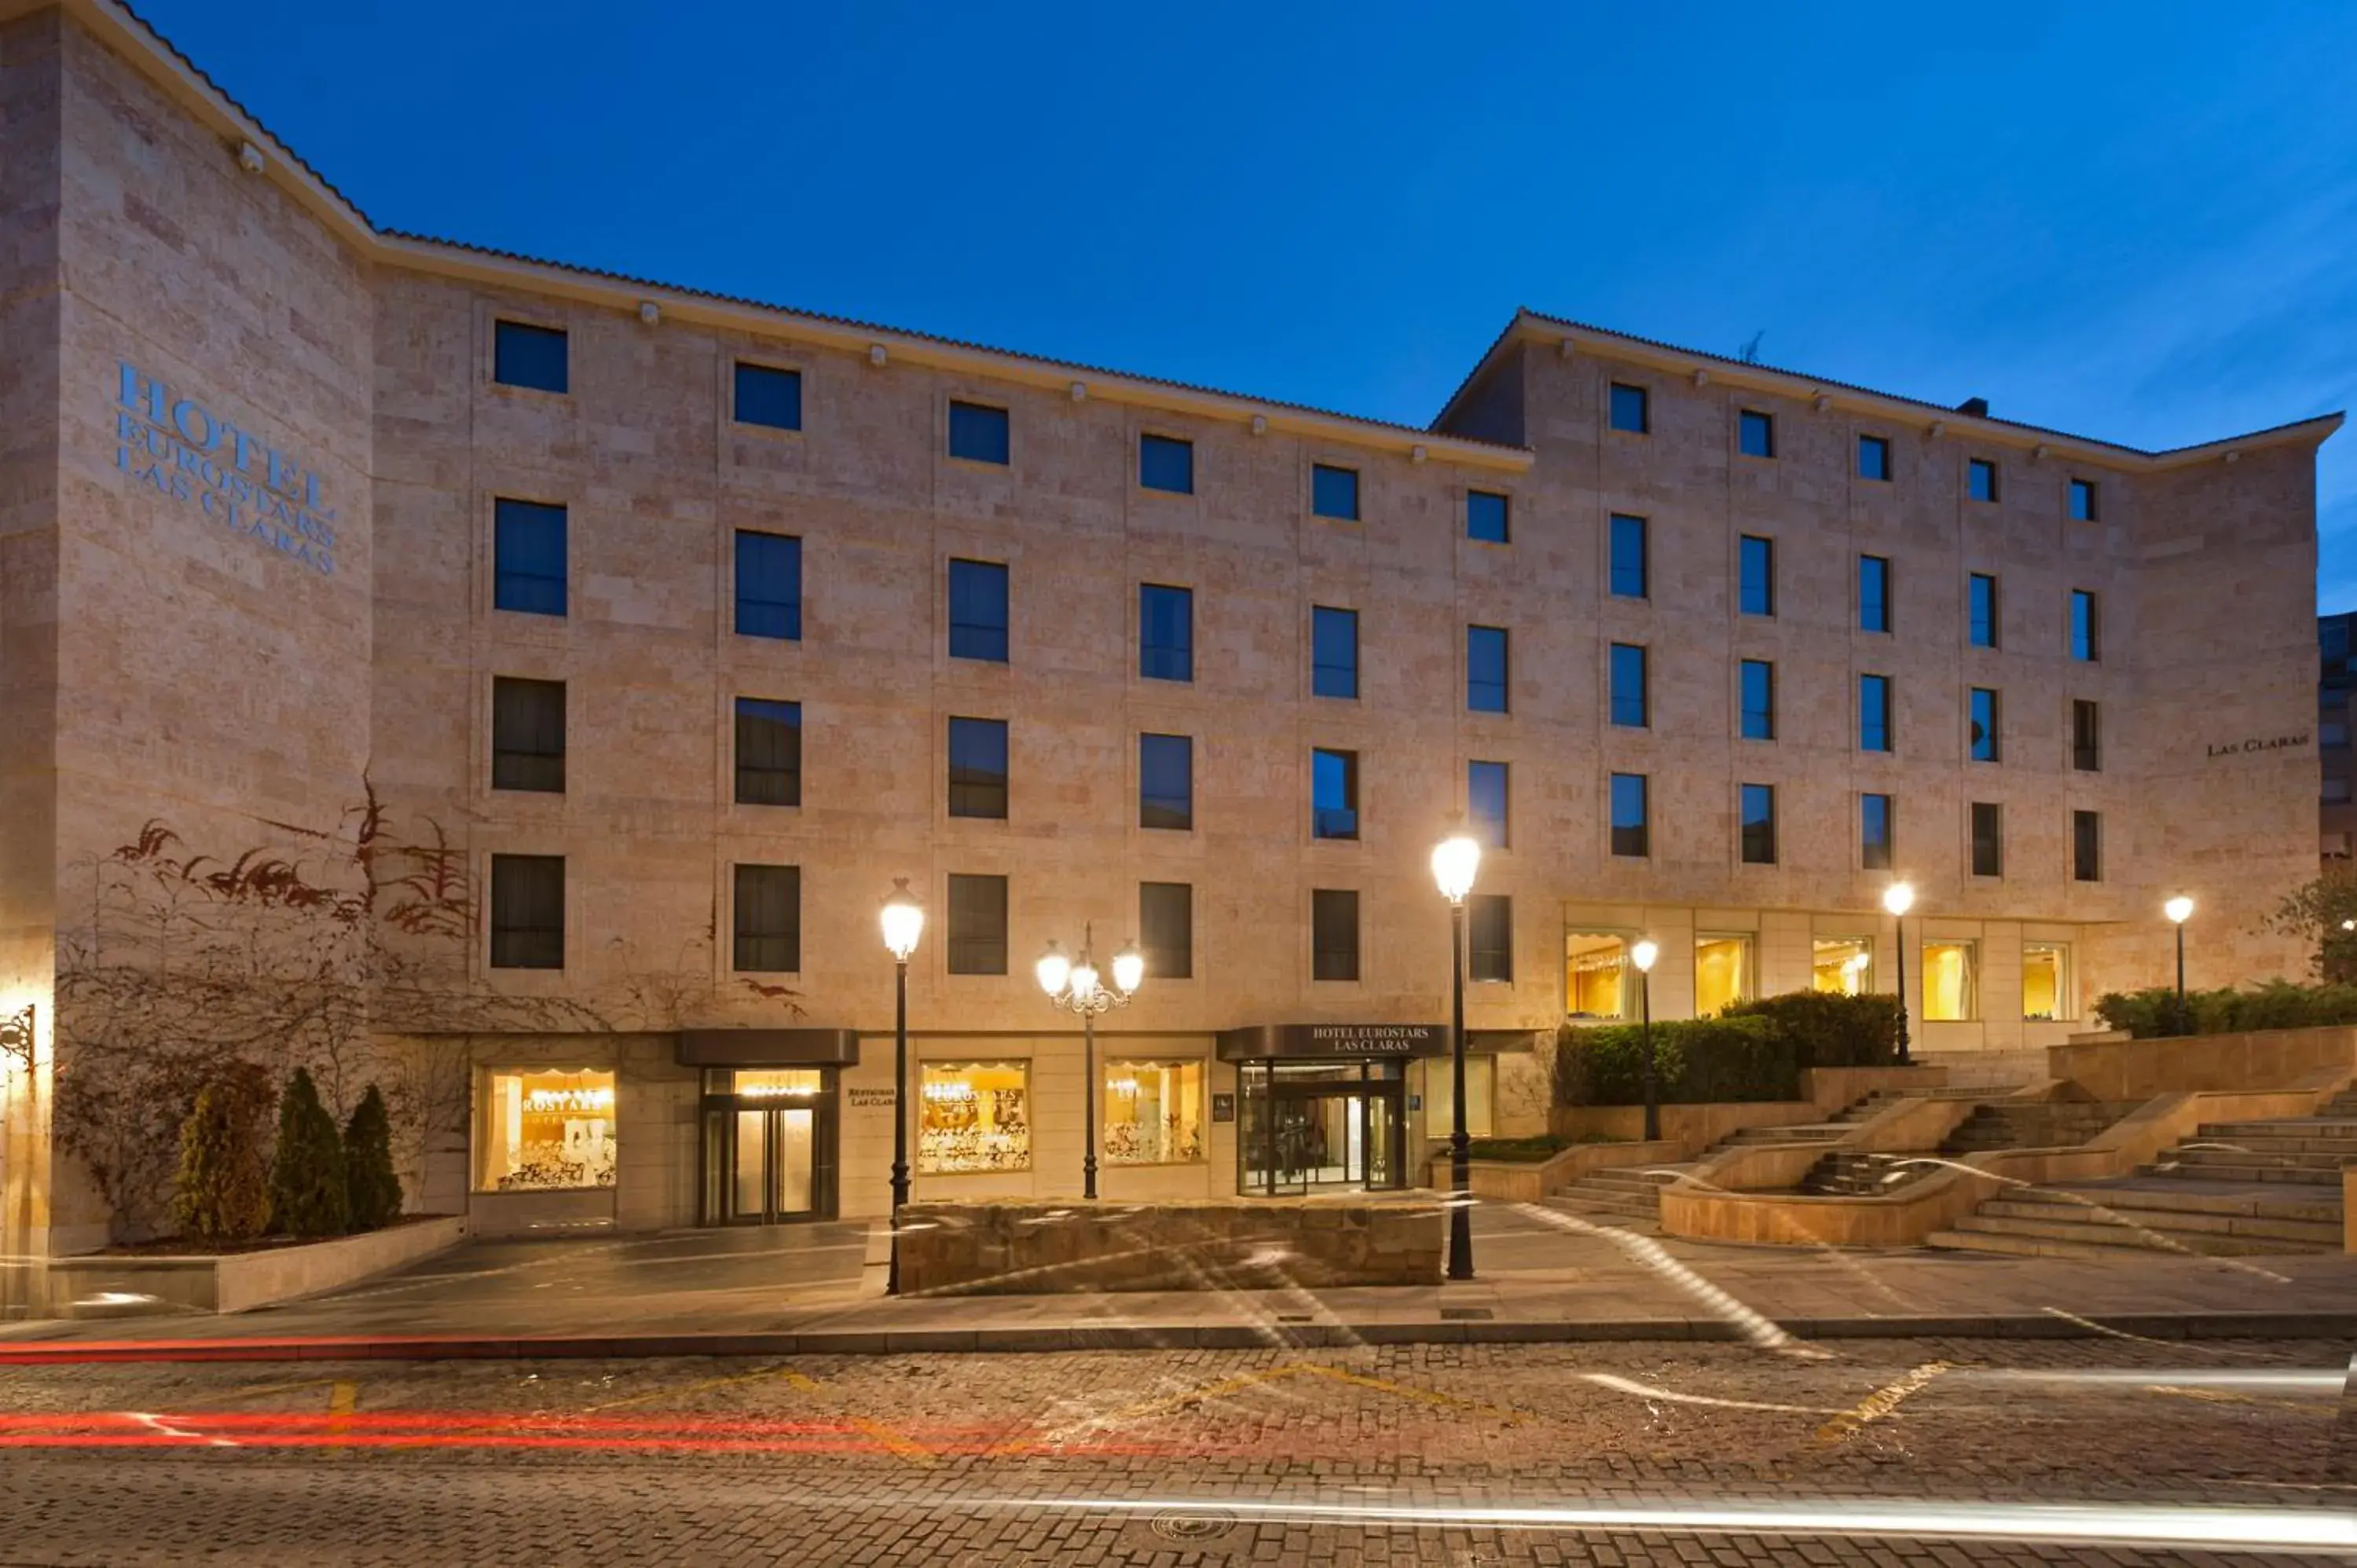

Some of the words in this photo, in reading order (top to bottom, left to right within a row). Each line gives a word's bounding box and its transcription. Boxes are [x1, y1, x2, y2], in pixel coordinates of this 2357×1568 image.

[118, 361, 335, 520] HOTEL
[116, 410, 335, 548] EUROSTARS
[116, 445, 192, 502] LAS
[200, 490, 336, 577] CLARAS
[2207, 743, 2238, 757] LAS
[2244, 735, 2308, 752] CLARAS
[1313, 1027, 1356, 1039] HOTEL
[1358, 1027, 1429, 1039] EUROSTARS
[1335, 1039, 1358, 1050] LAS
[1360, 1039, 1409, 1050] CLARAS
[871, 1097, 896, 1106] CLAR
